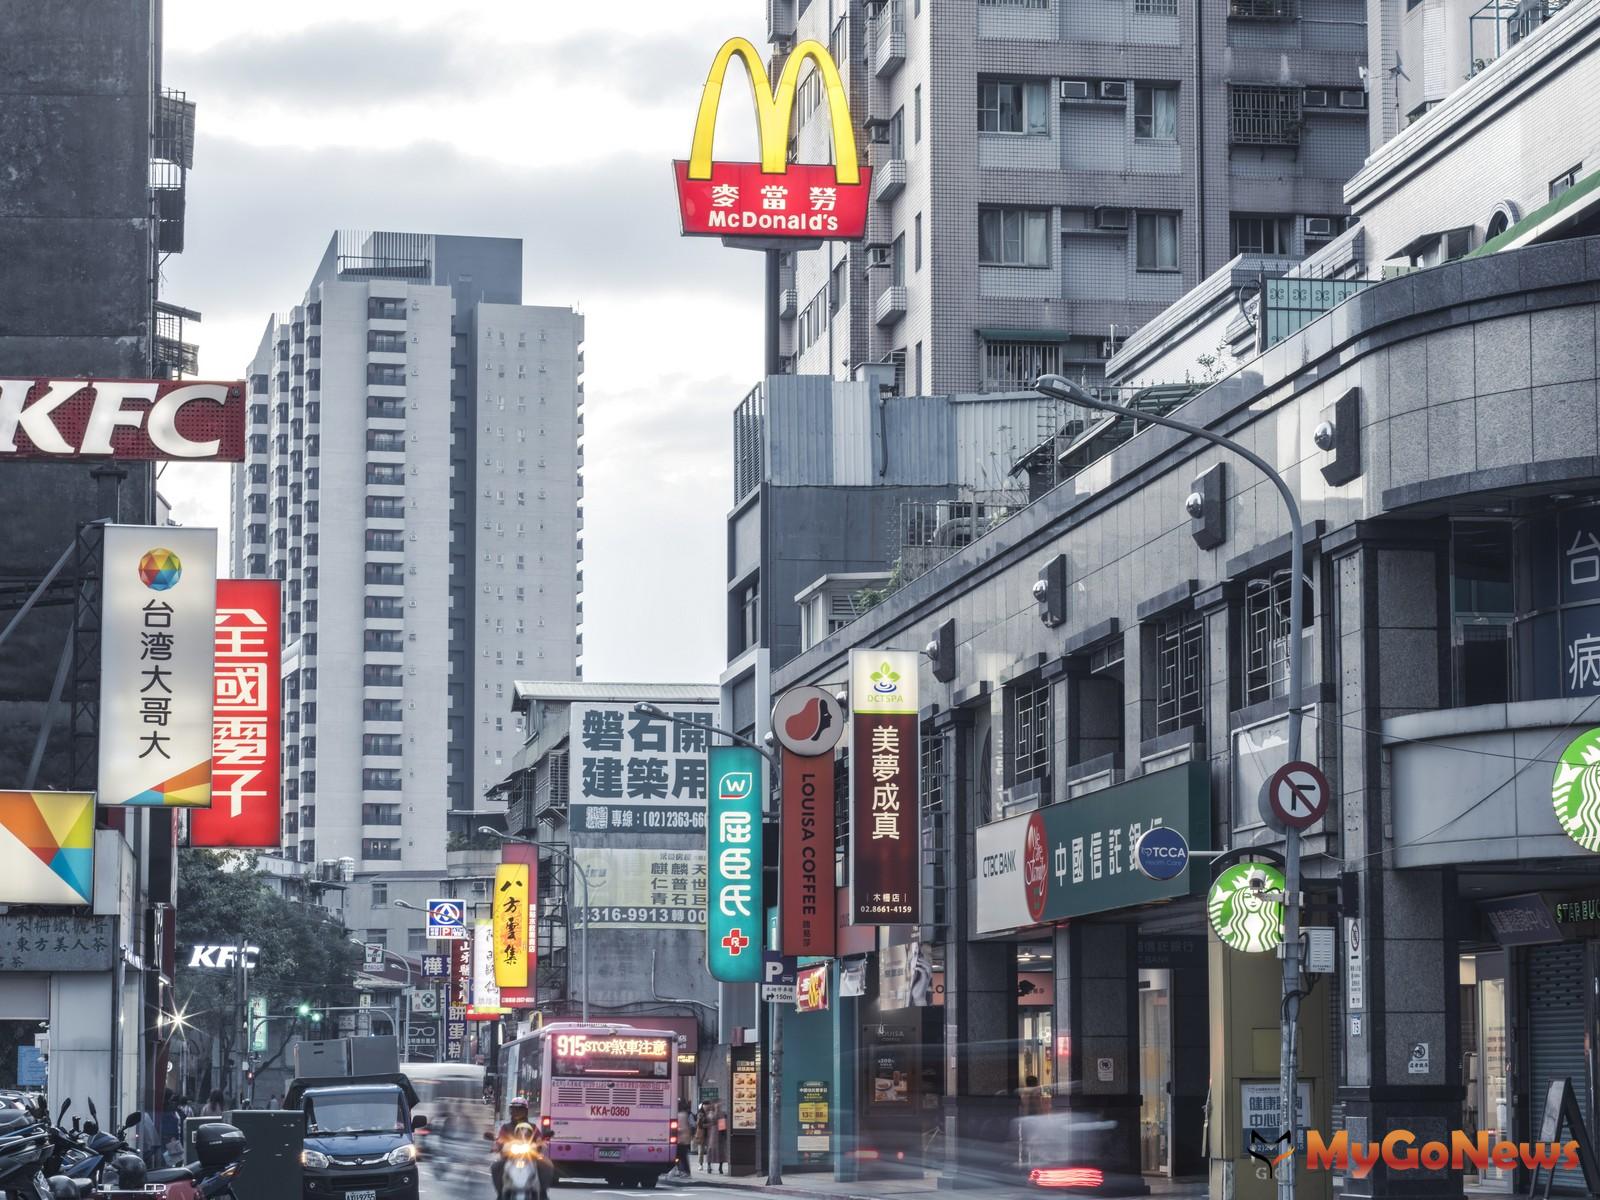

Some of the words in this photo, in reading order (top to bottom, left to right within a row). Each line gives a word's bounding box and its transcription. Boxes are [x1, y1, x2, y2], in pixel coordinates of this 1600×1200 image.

[712, 184, 837, 211] 麥當勞
[708, 211, 838, 231] McDonald's
[0, 380, 229, 457] KFC
[212, 608, 268, 818] 全國電子
[872, 725, 900, 840] 美夢成真
[801, 774, 815, 841] LOUISA
[719, 811, 751, 916] 屈臣氏
[983, 854, 998, 878] CTBC
[1000, 850, 1016, 874] BANK
[1153, 847, 1186, 858] TCCA
[802, 847, 816, 915] COFFEE
[860, 905, 912, 913] 02.8661-4159
[188, 945, 260, 969] KFC
[766, 962, 783, 982] P
[557, 1035, 587, 1057] 915
[590, 1106, 630, 1117] KKA-0360
